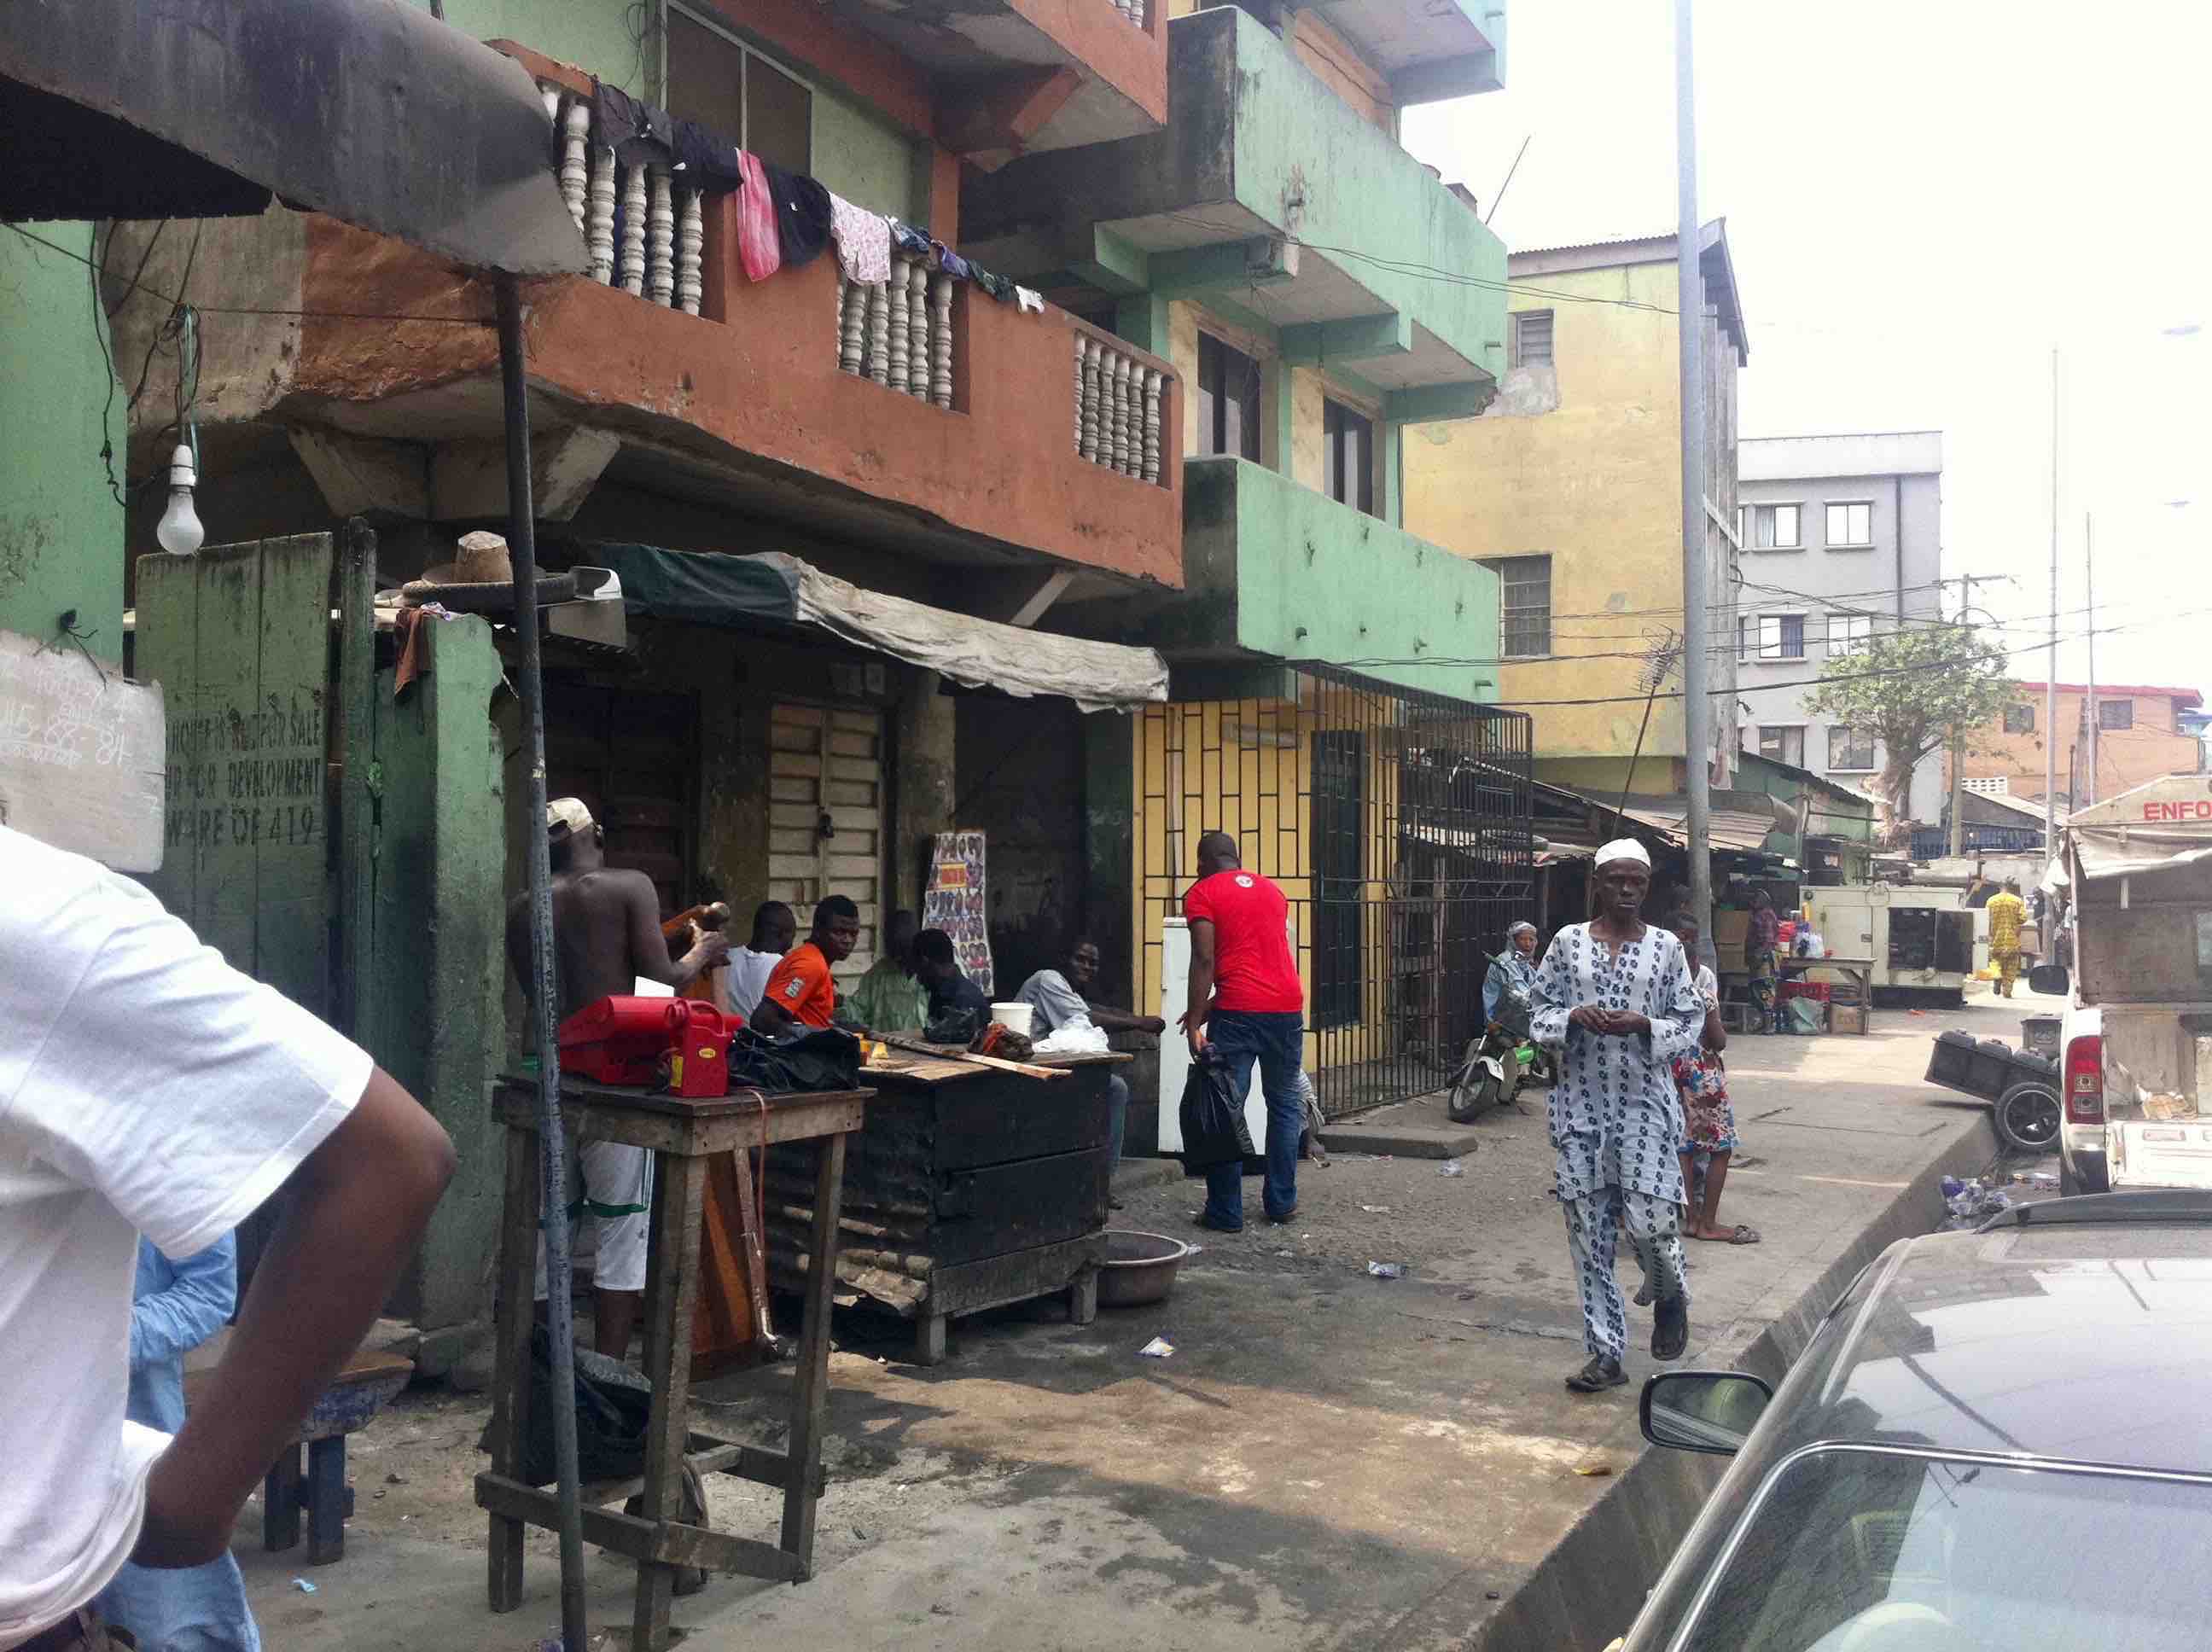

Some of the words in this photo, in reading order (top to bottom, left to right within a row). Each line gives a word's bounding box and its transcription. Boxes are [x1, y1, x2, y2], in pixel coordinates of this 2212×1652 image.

[290, 711, 320, 746] SALE
[229, 758, 321, 799] DEVELOPMENT
[231, 805, 261, 846] OF
[270, 806, 313, 846] 419
[2143, 800, 2211, 821] ENFO
